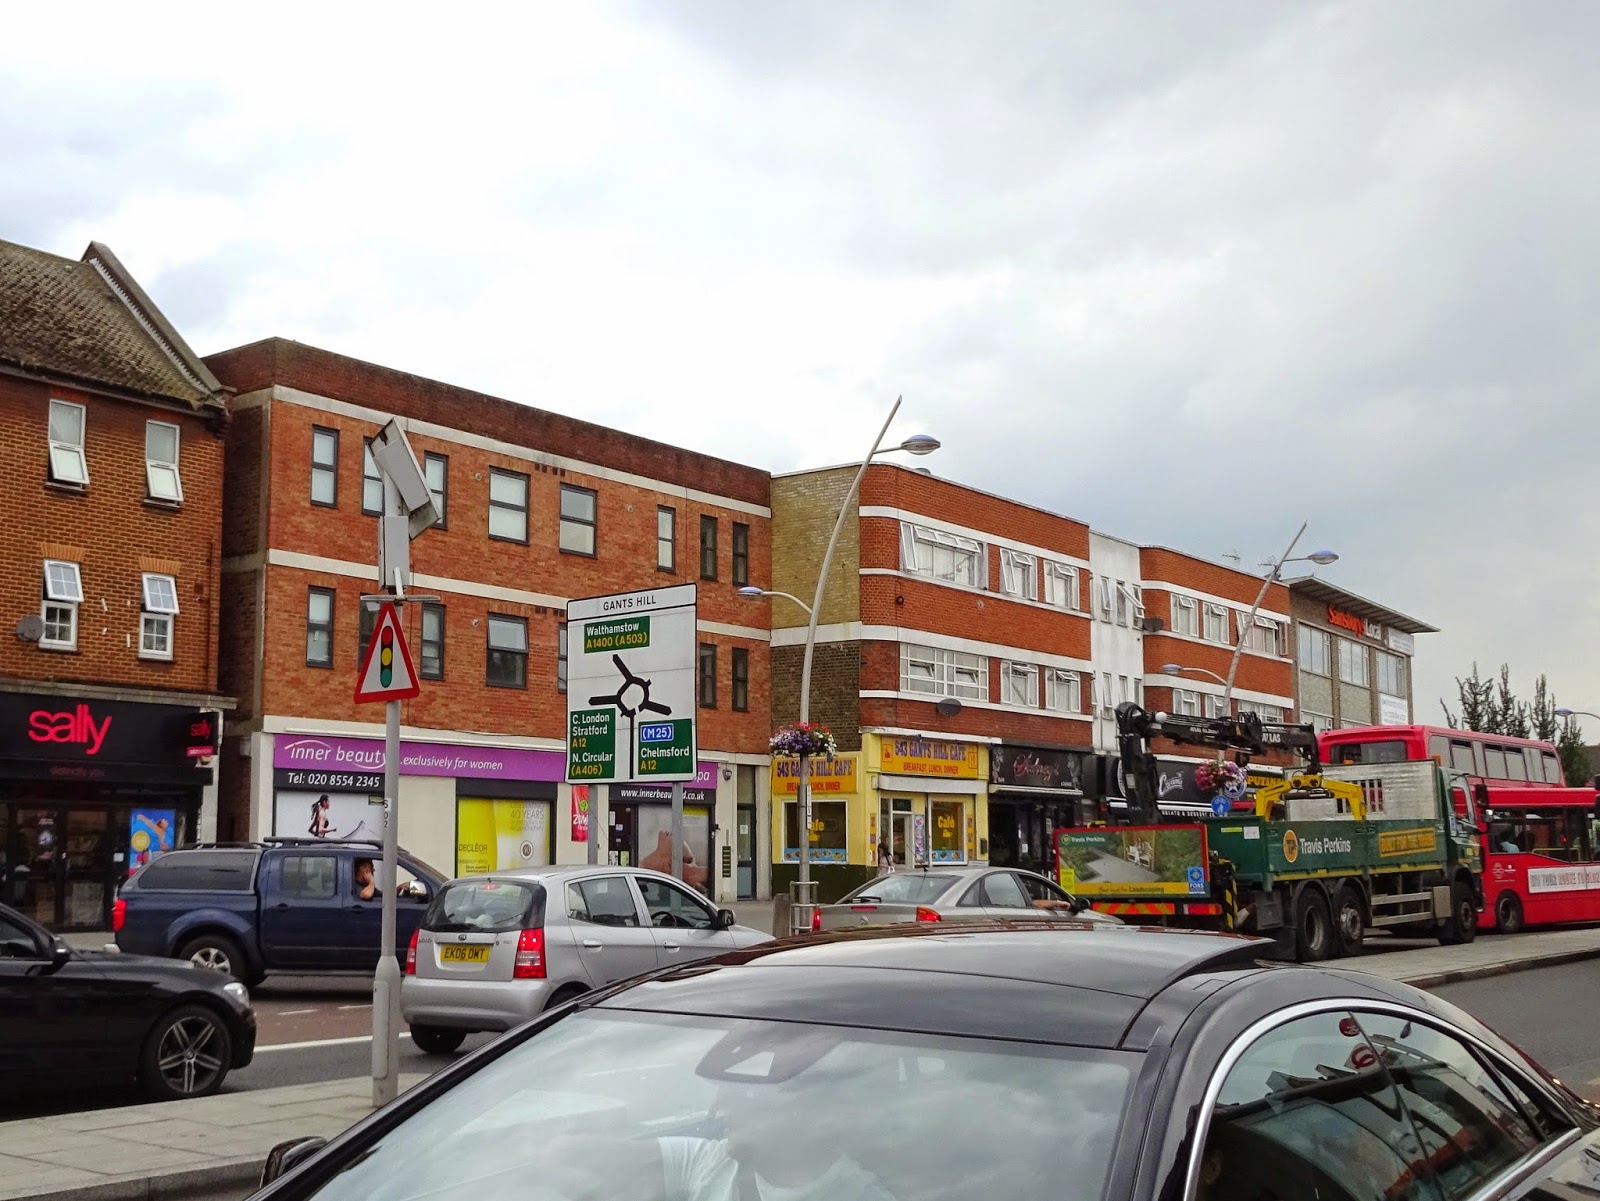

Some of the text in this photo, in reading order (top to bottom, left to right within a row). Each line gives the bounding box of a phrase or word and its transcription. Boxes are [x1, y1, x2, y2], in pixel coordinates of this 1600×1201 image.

[603, 595, 657, 611] GANTS HILL
[586, 621, 640, 636] Walthamstow
[586, 633, 648, 649] A1400 (A503)
[572, 713, 610, 724] C. London
[27, 704, 113, 755] sally
[190, 719, 213, 740] sally
[572, 725, 608, 736] Stratford
[642, 726, 673, 740] (M25)
[572, 738, 587, 748] A12
[291, 745, 332, 760] inner
[572, 752, 613, 763] N. Circular
[640, 746, 690, 758] Chelmsford
[894, 740, 966, 761] 543 GANTS HILL CAFE
[453, 757, 468, 770] for
[469, 760, 503, 770] women
[571, 765, 603, 776] (A406)
[640, 759, 657, 770] A12
[777, 760, 853, 777] 543 GAS HILL CAFE
[288, 773, 381, 788] Tel: 020 8554 2345
[522, 809, 545, 820] YEARS
[1299, 837, 1351, 854] Travis Perkins
[444, 948, 466, 959] EK06
